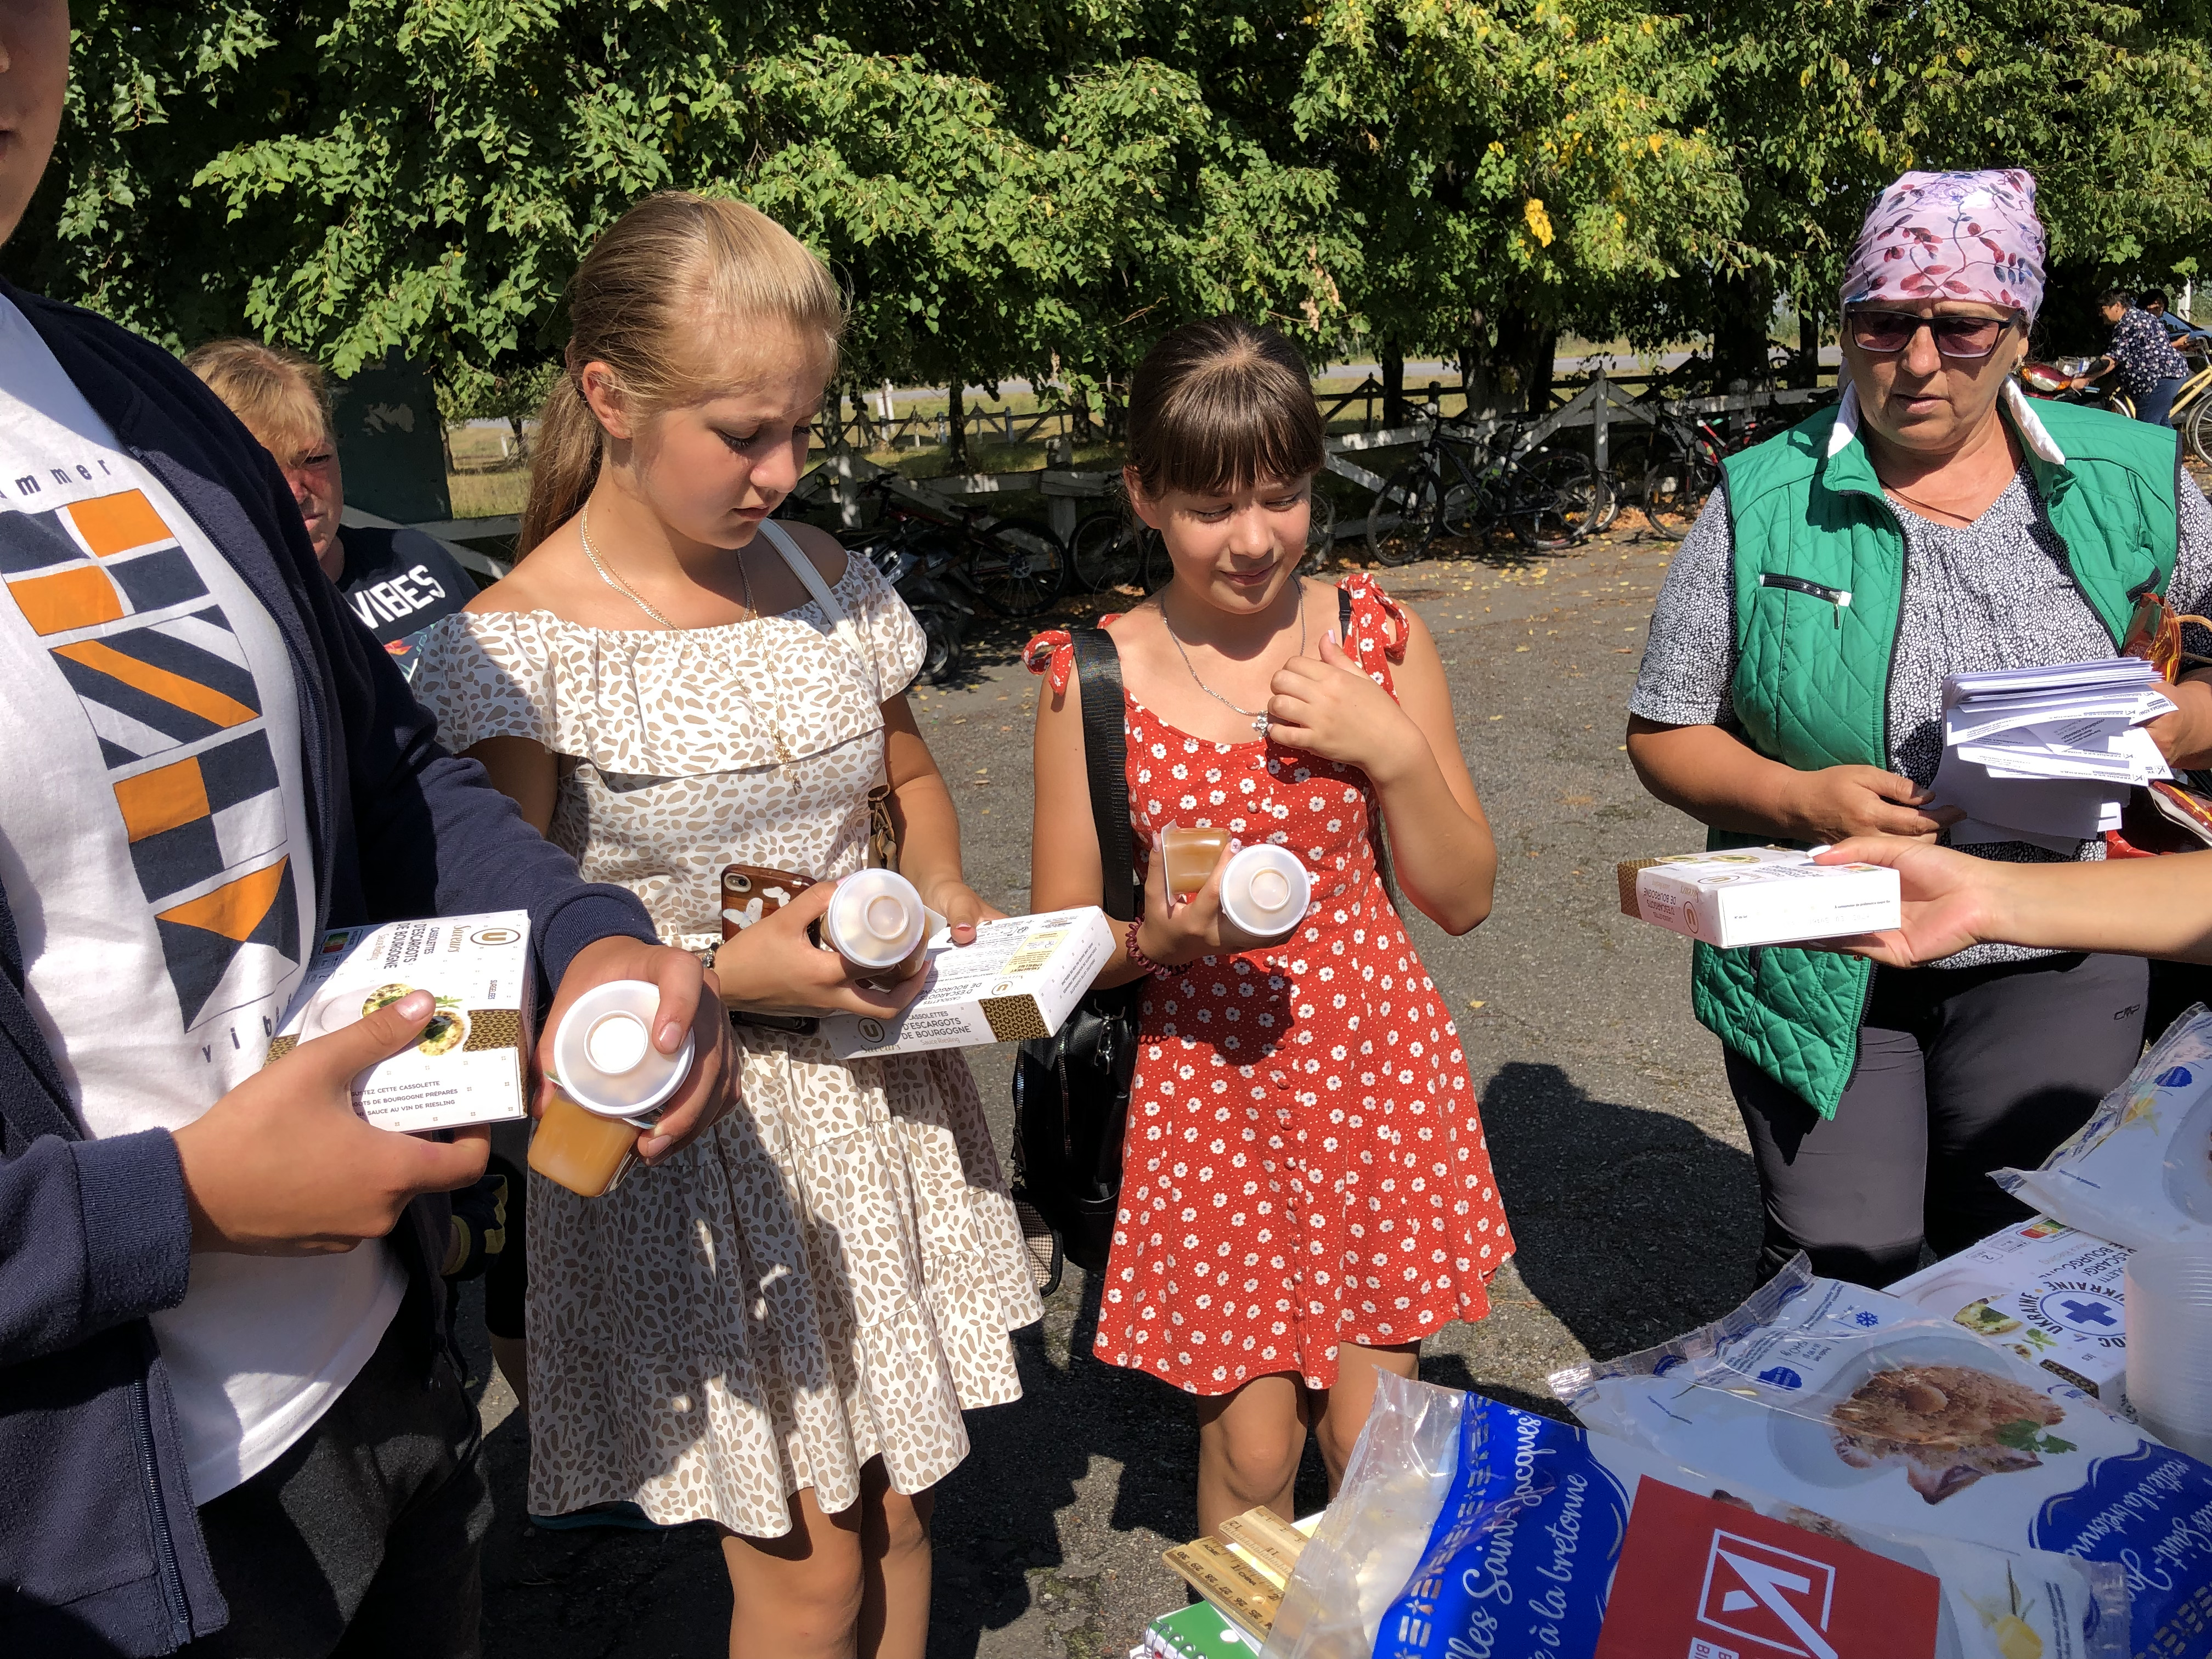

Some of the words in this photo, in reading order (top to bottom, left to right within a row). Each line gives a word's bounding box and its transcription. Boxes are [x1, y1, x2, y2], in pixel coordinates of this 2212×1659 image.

[0, 459, 111, 499] mmer
[348, 565, 445, 629] VIBES
[396, 922, 411, 931] DE
[403, 923, 427, 963] D'ESCARGOTS
[424, 927, 440, 955] CASSOLETTES
[448, 924, 472, 953] Saveurs
[383, 930, 409, 969] BOURGOGNE
[919, 984, 969, 996] BOURGOGNE
[919, 989, 973, 1001] D'ESCARGOTS
[923, 996, 961, 1005] CASSOLETTES
[907, 1011, 949, 1020] CASSOLETTES
[2113, 1005, 2140, 1020] CMP
[902, 1017, 961, 1030] D'ESCARGOTS
[901, 1031, 915, 1040] DE
[916, 1025, 971, 1037] BOURGOGNE
[938, 1036, 960, 1045] Riesling
[860, 1043, 901, 1054] Saveurs
[399, 1081, 440, 1090] CASSOLETTE
[383, 1093, 424, 1103] BOURGOGNE
[425, 1089, 458, 1098] PRÉPARÉS
[425, 1099, 455, 1108] RIESLING
[2019, 1292, 2063, 1334] UKRAINE
[1537, 1473, 1589, 1582] bretonne
[1204, 1573, 1218, 1583] 28
[1218, 1586, 1233, 1595] 27
[1234, 1597, 1248, 1607] 26
[1248, 1609, 1262, 1620] 25
[1528, 1585, 1567, 1619] la
[1528, 1622, 1561, 1646] à
